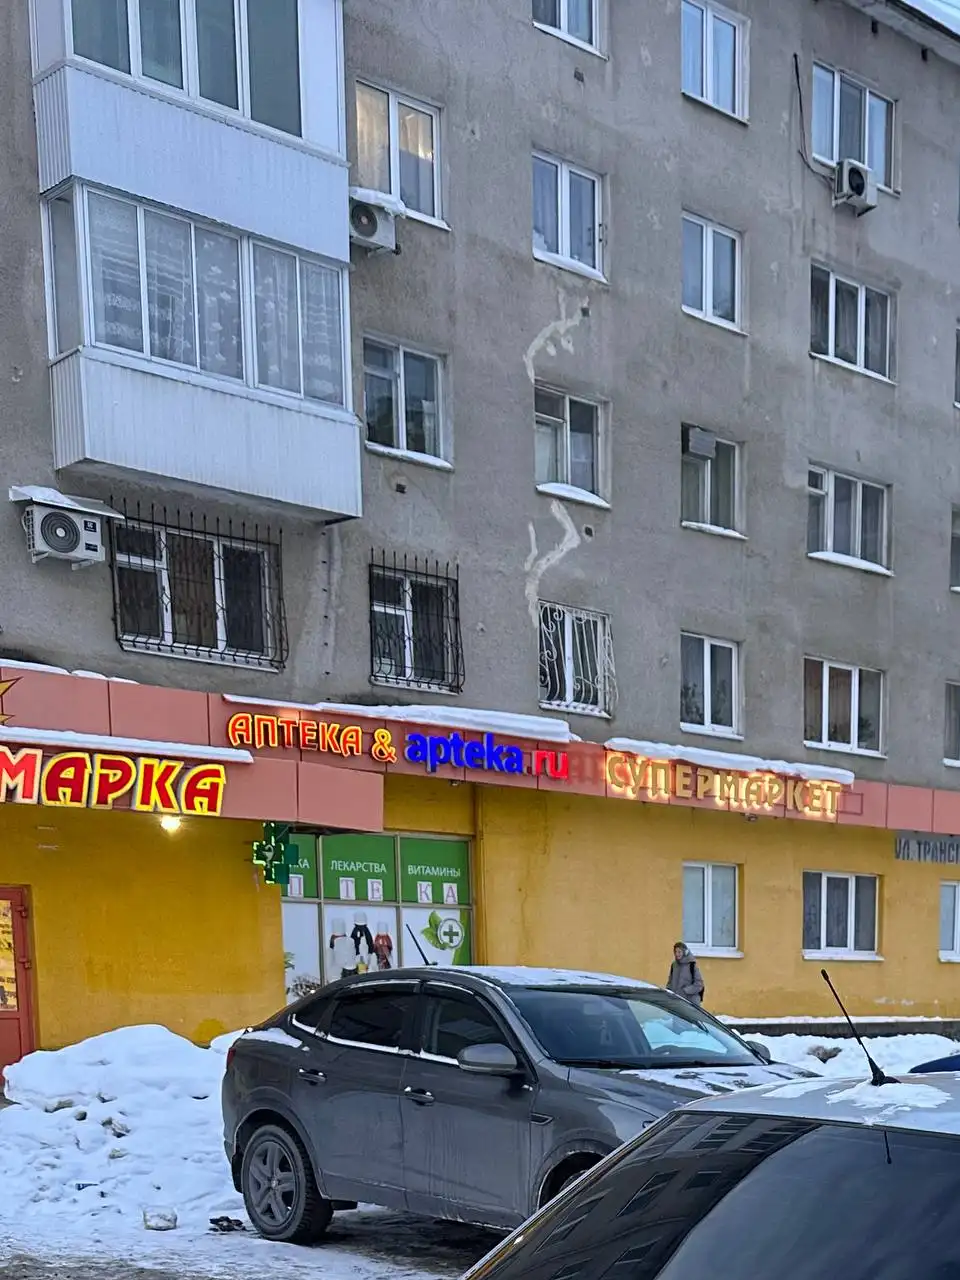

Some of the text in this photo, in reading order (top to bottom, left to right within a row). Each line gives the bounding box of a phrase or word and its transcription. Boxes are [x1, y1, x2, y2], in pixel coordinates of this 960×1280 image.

[228, 713, 363, 757] АПТЕКА
[371, 728, 398, 764] &
[405, 731, 568, 780] apteka.ru
[0, 745, 226, 816] МАРКА
[606, 755, 842, 815] СУПЕРМАРКЕТ
[330, 859, 387, 874] ЛЕКАРСТВА
[407, 864, 461, 878] ВИТАМИНЫ
